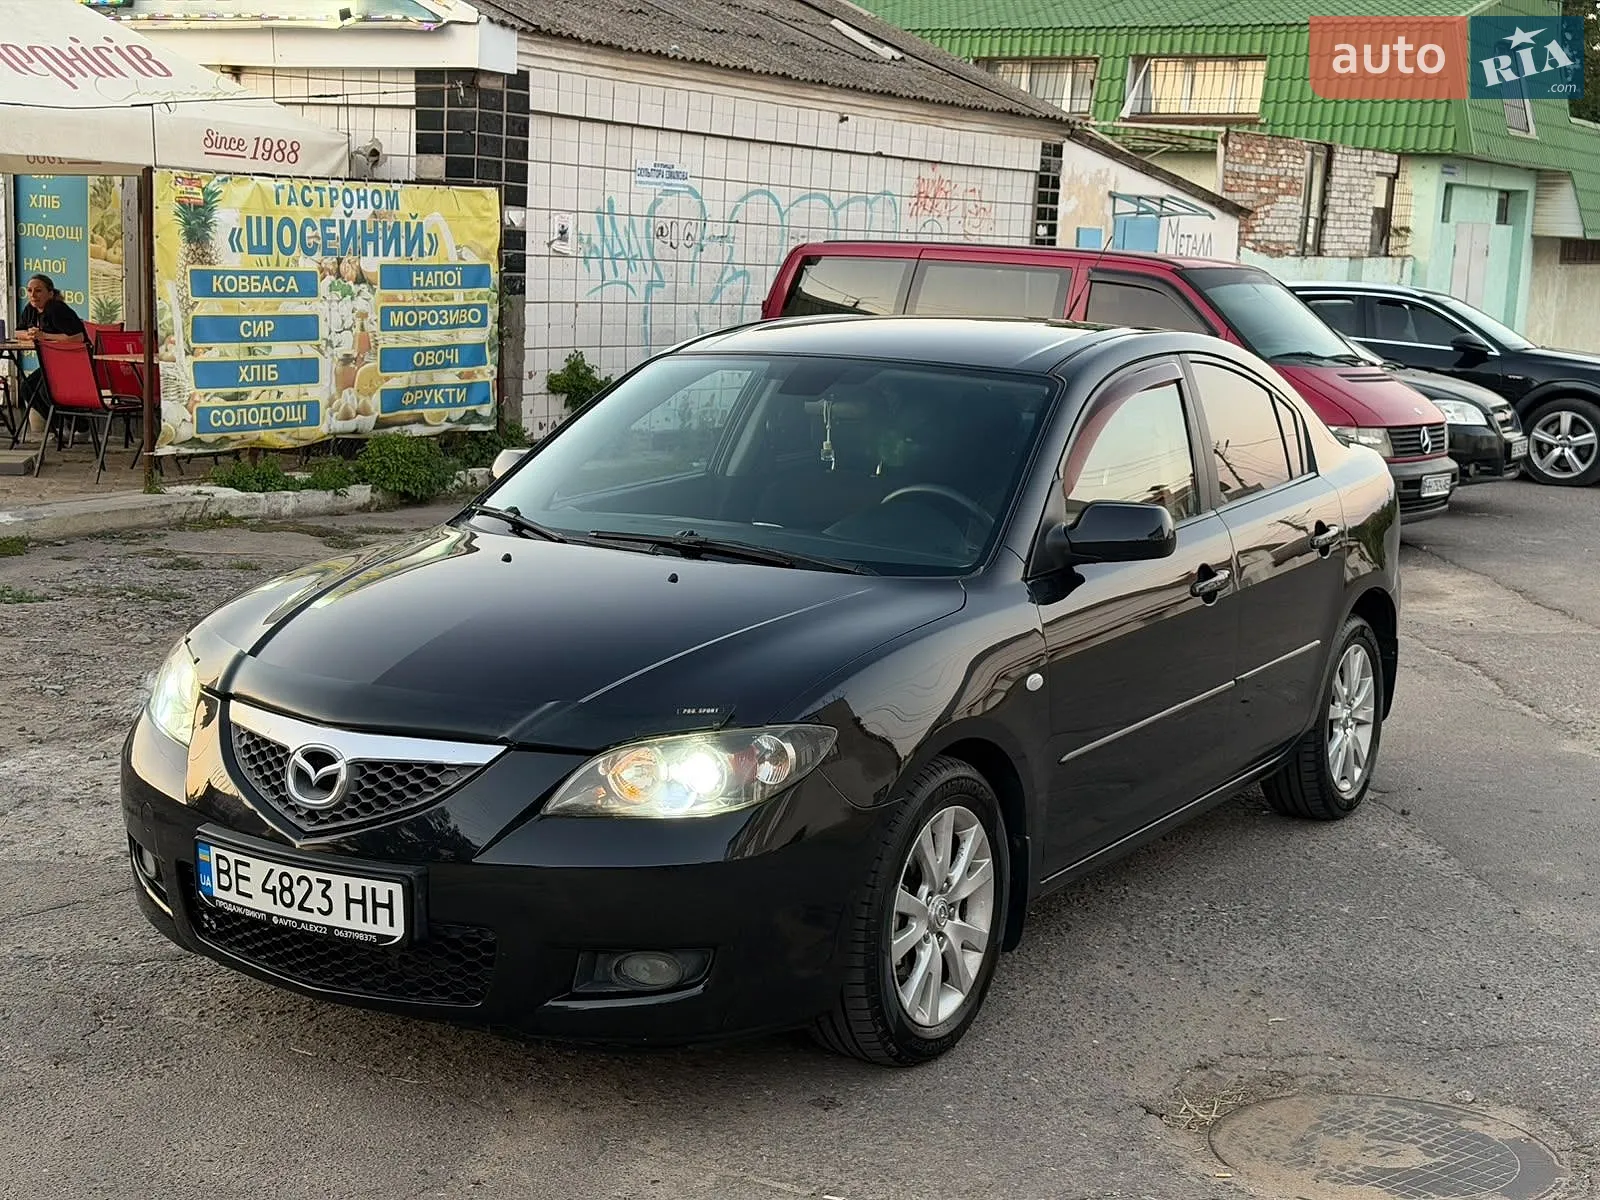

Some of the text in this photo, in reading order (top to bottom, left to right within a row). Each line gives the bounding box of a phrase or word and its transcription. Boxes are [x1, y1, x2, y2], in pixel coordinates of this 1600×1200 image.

[0, 36, 173, 89] ернігів
[203, 128, 301, 164] Since 1988
[29, 194, 61, 209] ХЛІБ
[273, 184, 400, 211] ГАСТРОНОМ
[16, 222, 83, 242] ОЛОДОЩІ
[228, 211, 439, 257] «ШОСЕЙНИЙ»
[24, 257, 67, 274] НАПОЇ
[212, 275, 299, 293] КОВБАСА
[412, 267, 462, 287] НАПОЇ
[390, 308, 482, 327] МОРОЗИВО
[239, 320, 275, 338] СИР
[413, 348, 459, 367] ОВОЧІ
[238, 363, 279, 383] ХЛІБ
[401, 388, 467, 406] ФРУКТИ
[210, 404, 307, 427] СОЛОДОЩІ
[200, 875, 212, 888] UA
[215, 853, 395, 928] BE 4823 HH
[215, 899, 267, 921] ПРОДАЖ/ВИКУП
[334, 929, 378, 943] 0637198375
